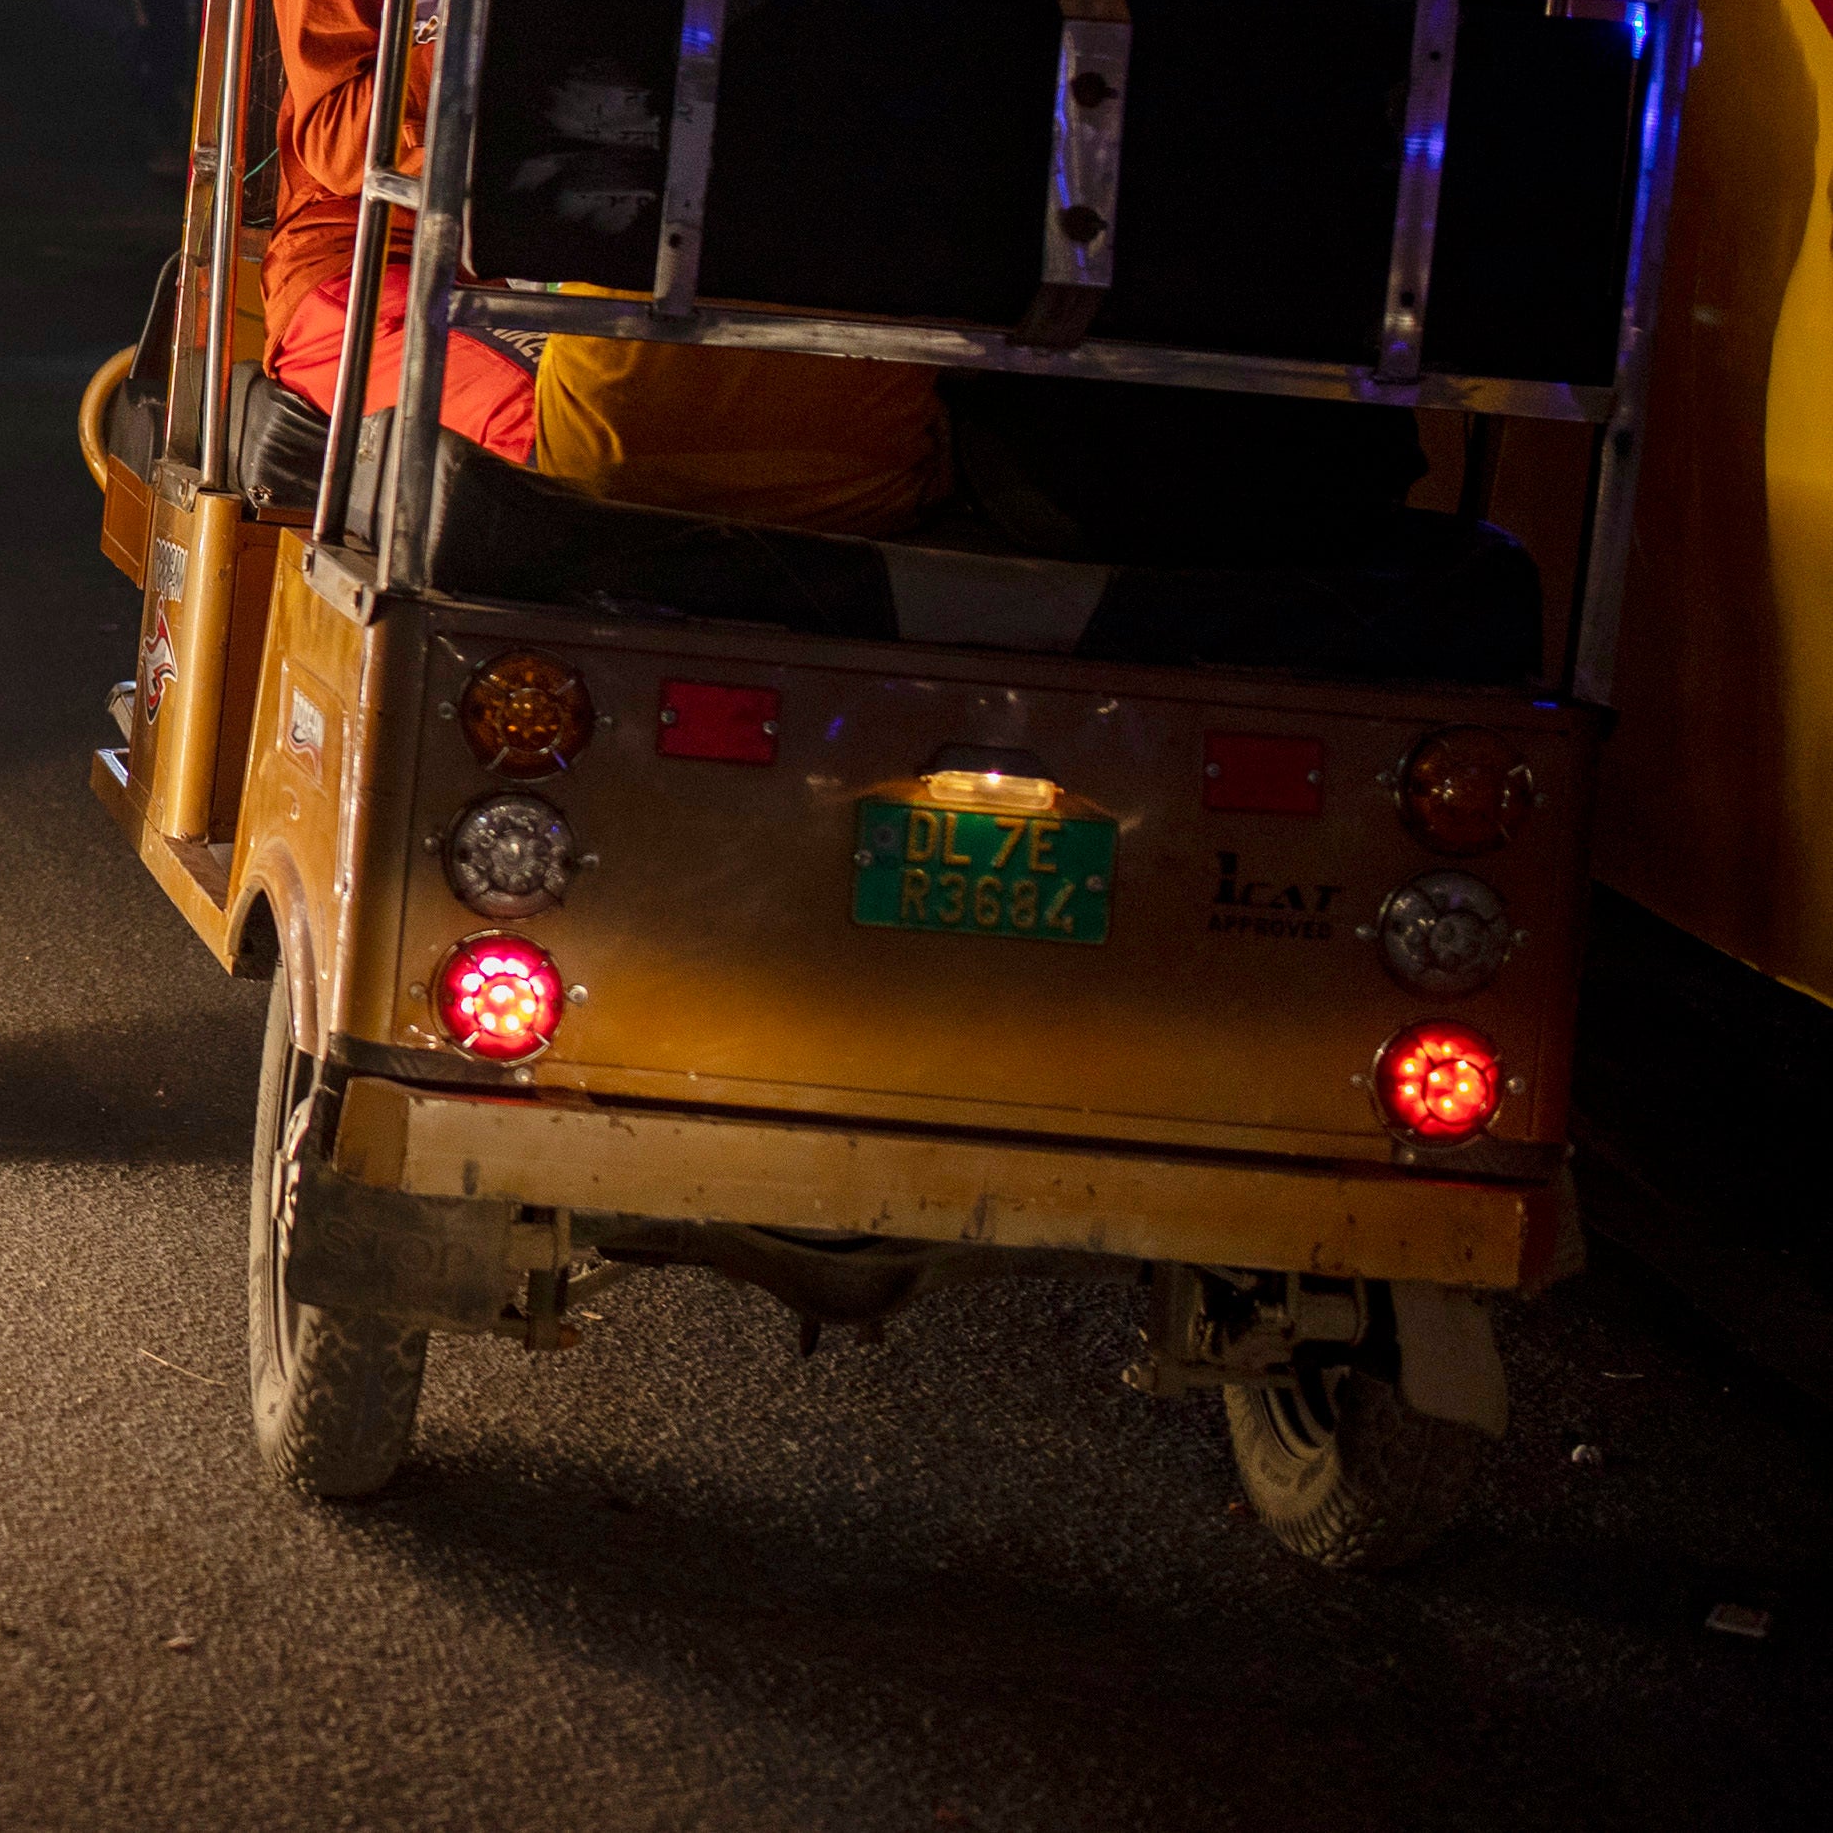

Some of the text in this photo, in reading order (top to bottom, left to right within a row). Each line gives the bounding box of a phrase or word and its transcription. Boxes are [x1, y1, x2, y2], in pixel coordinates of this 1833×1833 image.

[906, 808, 1061, 874] DL 7E
[901, 868, 1076, 934] R3684
[1208, 915, 1332, 940] APPROVED
